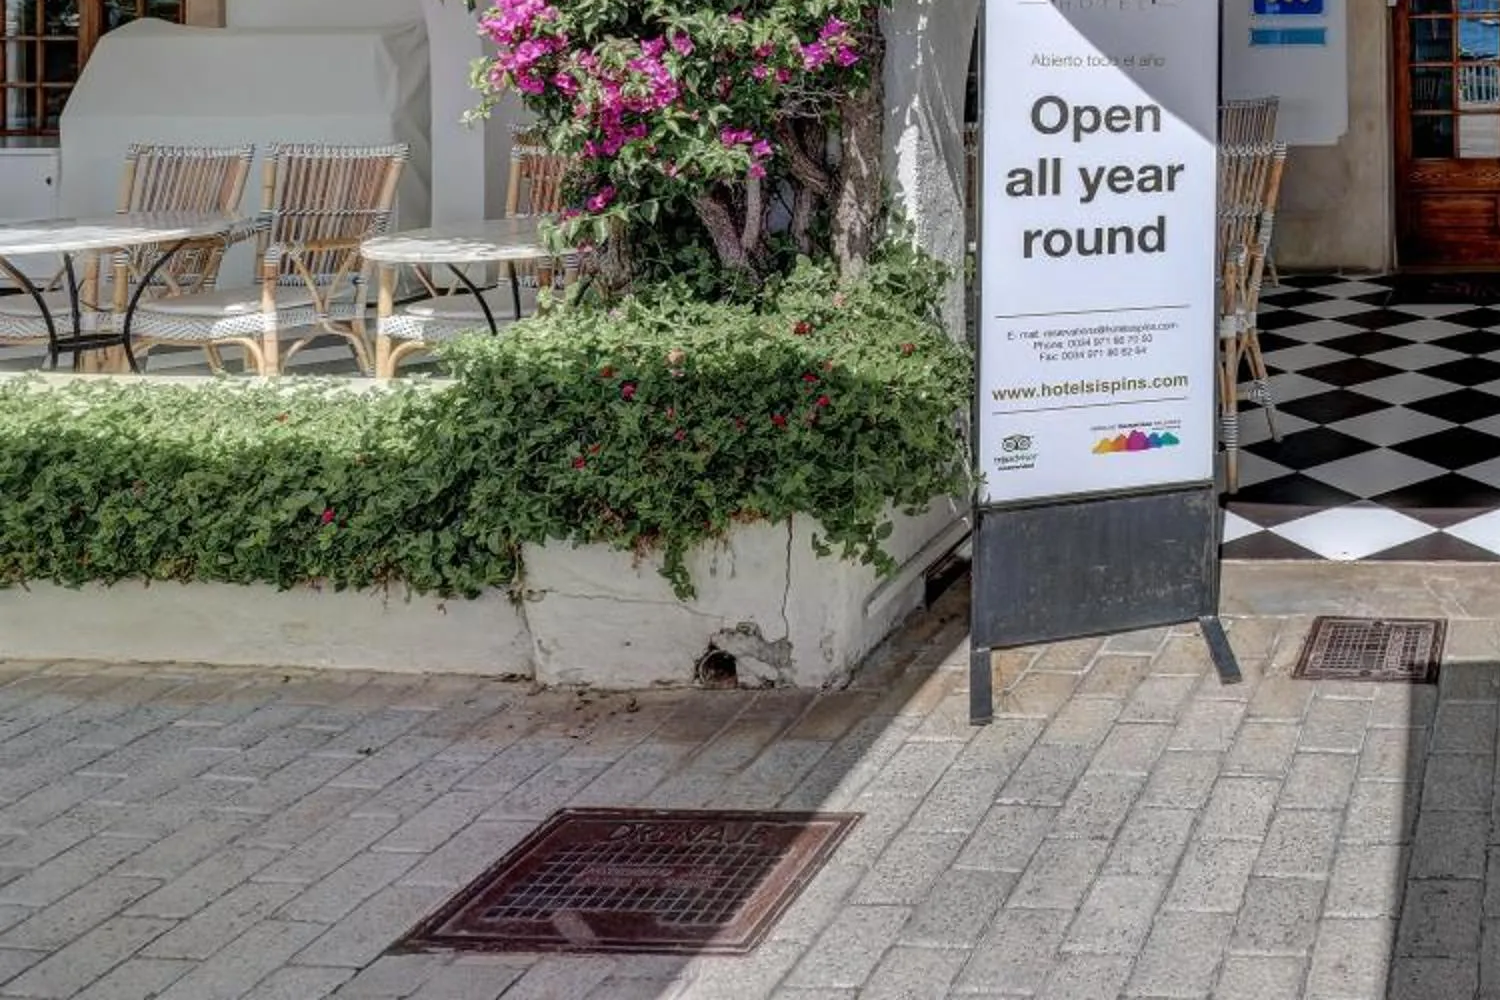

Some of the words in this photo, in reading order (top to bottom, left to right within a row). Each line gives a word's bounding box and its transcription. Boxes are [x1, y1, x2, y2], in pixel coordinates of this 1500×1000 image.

[1031, 53, 1083, 68] Abierto
[1087, 53, 1119, 68] todo
[1123, 53, 1135, 68] el
[1139, 53, 1166, 68] año
[1030, 94, 1161, 143] Open
[1005, 157, 1062, 198] all
[1078, 162, 1185, 204] year
[1023, 215, 1167, 259] round
[991, 375, 1189, 401] www.hotelsispins.com
